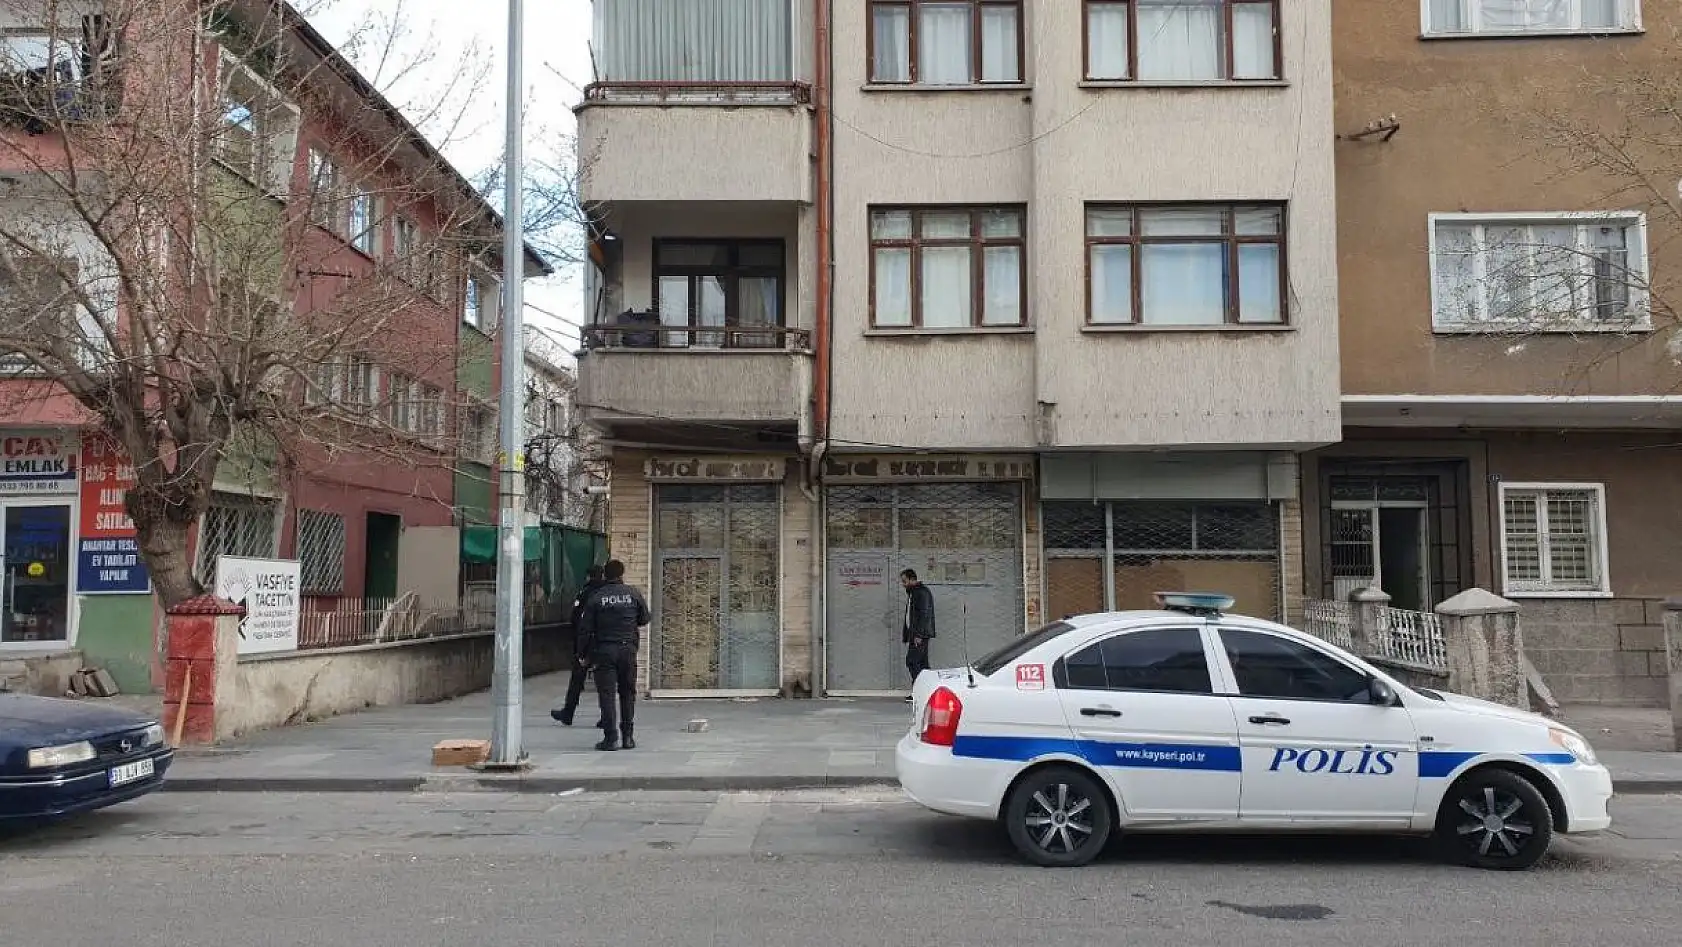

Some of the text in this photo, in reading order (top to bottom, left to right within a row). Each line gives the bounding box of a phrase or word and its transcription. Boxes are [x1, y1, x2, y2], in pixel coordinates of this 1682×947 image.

[5, 459, 65, 472] EMLAK
[92, 555, 102, 567] EV
[99, 569, 128, 582] YAPILIR
[1019, 666, 1040, 680] 112
[1115, 748, 1206, 763] www.kayseri.pol.tr
[1269, 743, 1398, 775] POLİS
